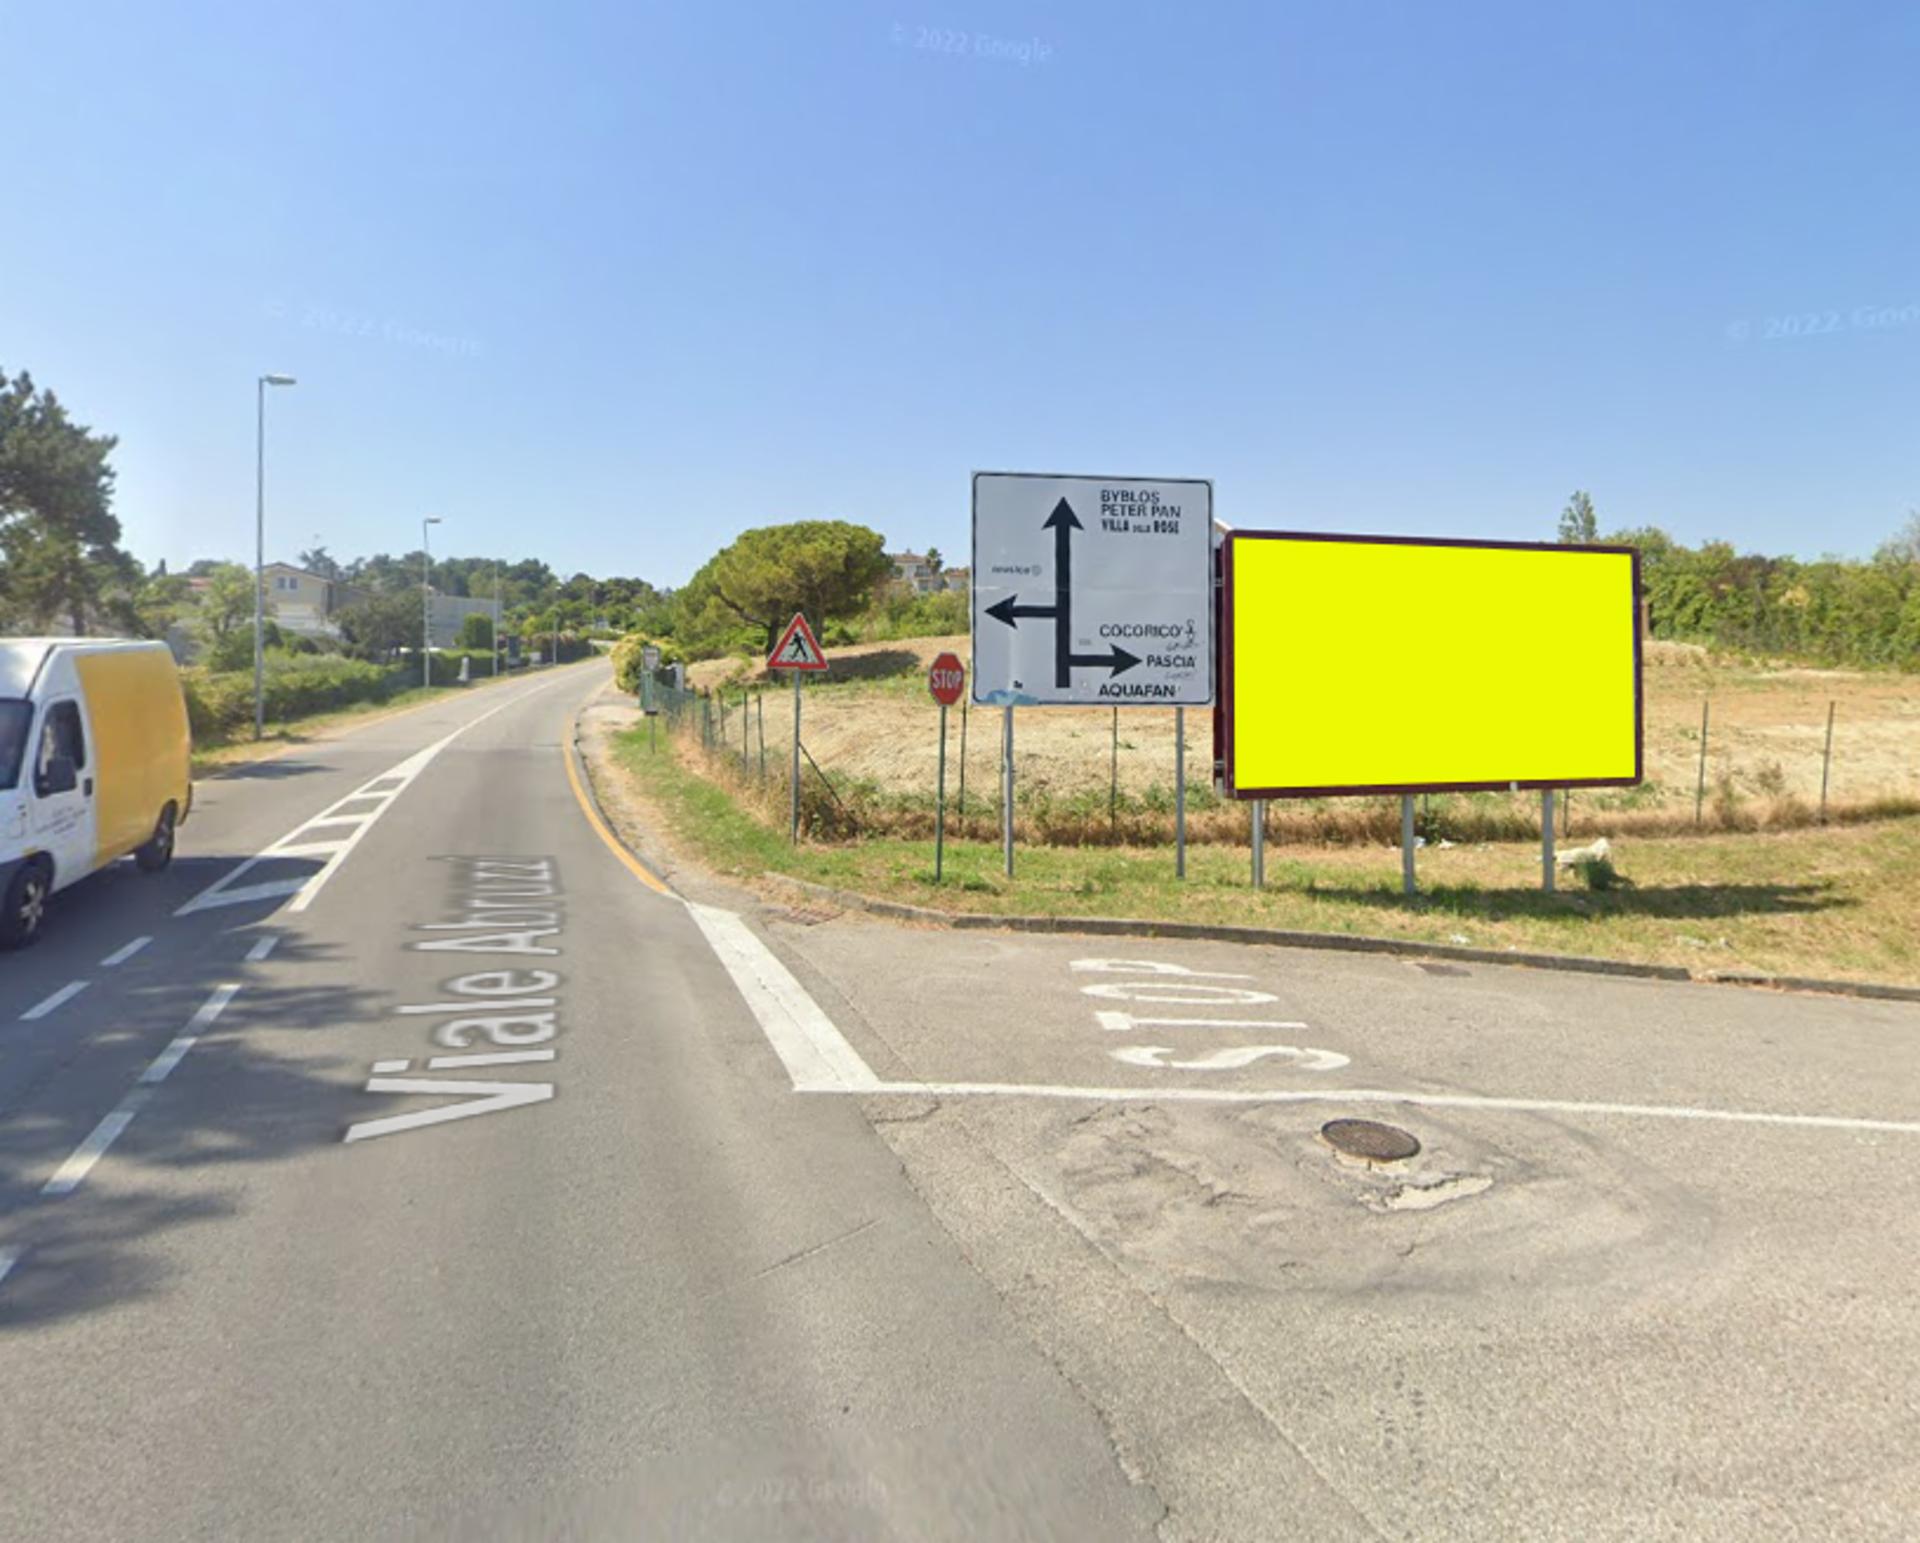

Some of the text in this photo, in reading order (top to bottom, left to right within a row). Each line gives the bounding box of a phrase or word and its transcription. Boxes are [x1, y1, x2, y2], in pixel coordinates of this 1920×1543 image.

[1101, 489, 1160, 504] BYBLOS
[1101, 503, 1181, 518] PETER PAN
[932, 669, 962, 689] STOP
[1099, 683, 1175, 697] AQUAFAN
[1069, 958, 1350, 1070] STOP
